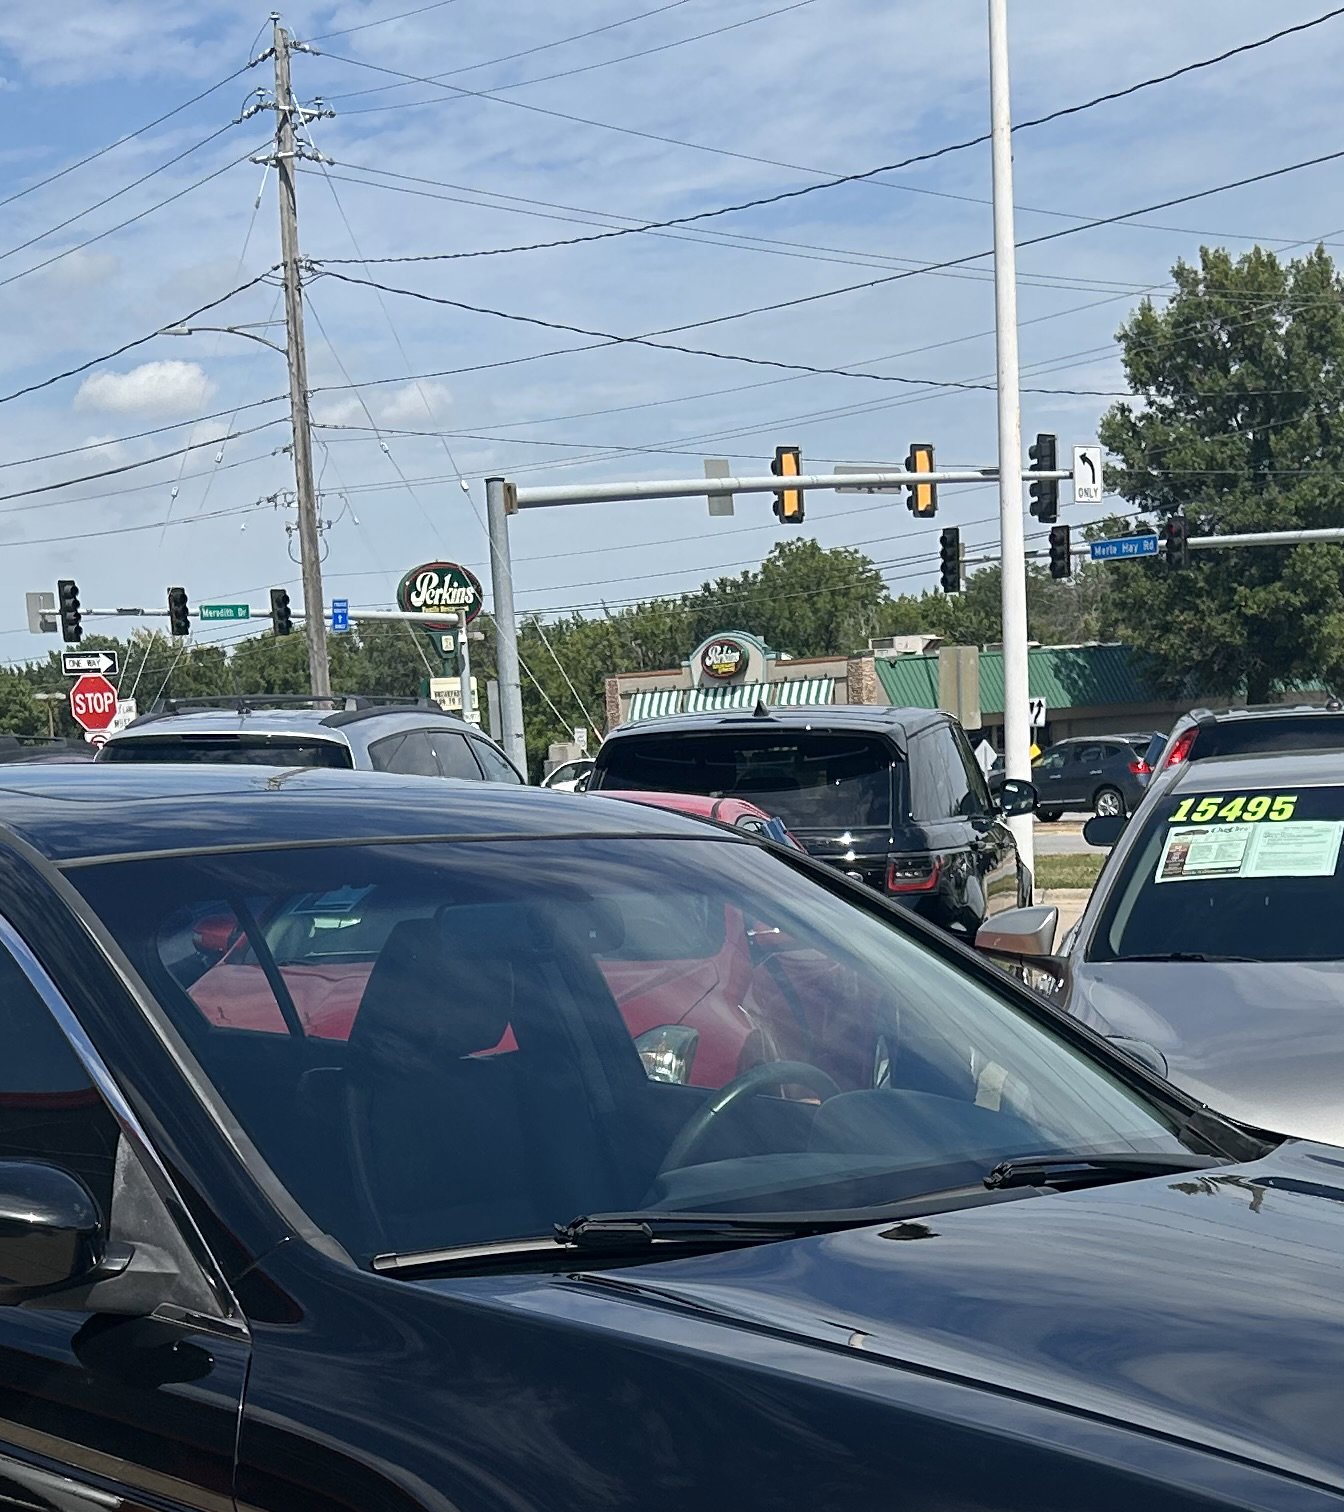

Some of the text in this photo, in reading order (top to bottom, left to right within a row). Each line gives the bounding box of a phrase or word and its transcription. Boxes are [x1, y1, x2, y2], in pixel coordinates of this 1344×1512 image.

[1078, 487, 1099, 498] ONLY
[1122, 542, 1139, 554] Hay
[1143, 539, 1154, 551] Rd
[410, 572, 474, 607] Perkins
[202, 605, 247, 618] Meredith Dr
[68, 659, 101, 668] ONE WAY
[75, 691, 114, 715] STOP
[1168, 796, 1298, 822] 15495
